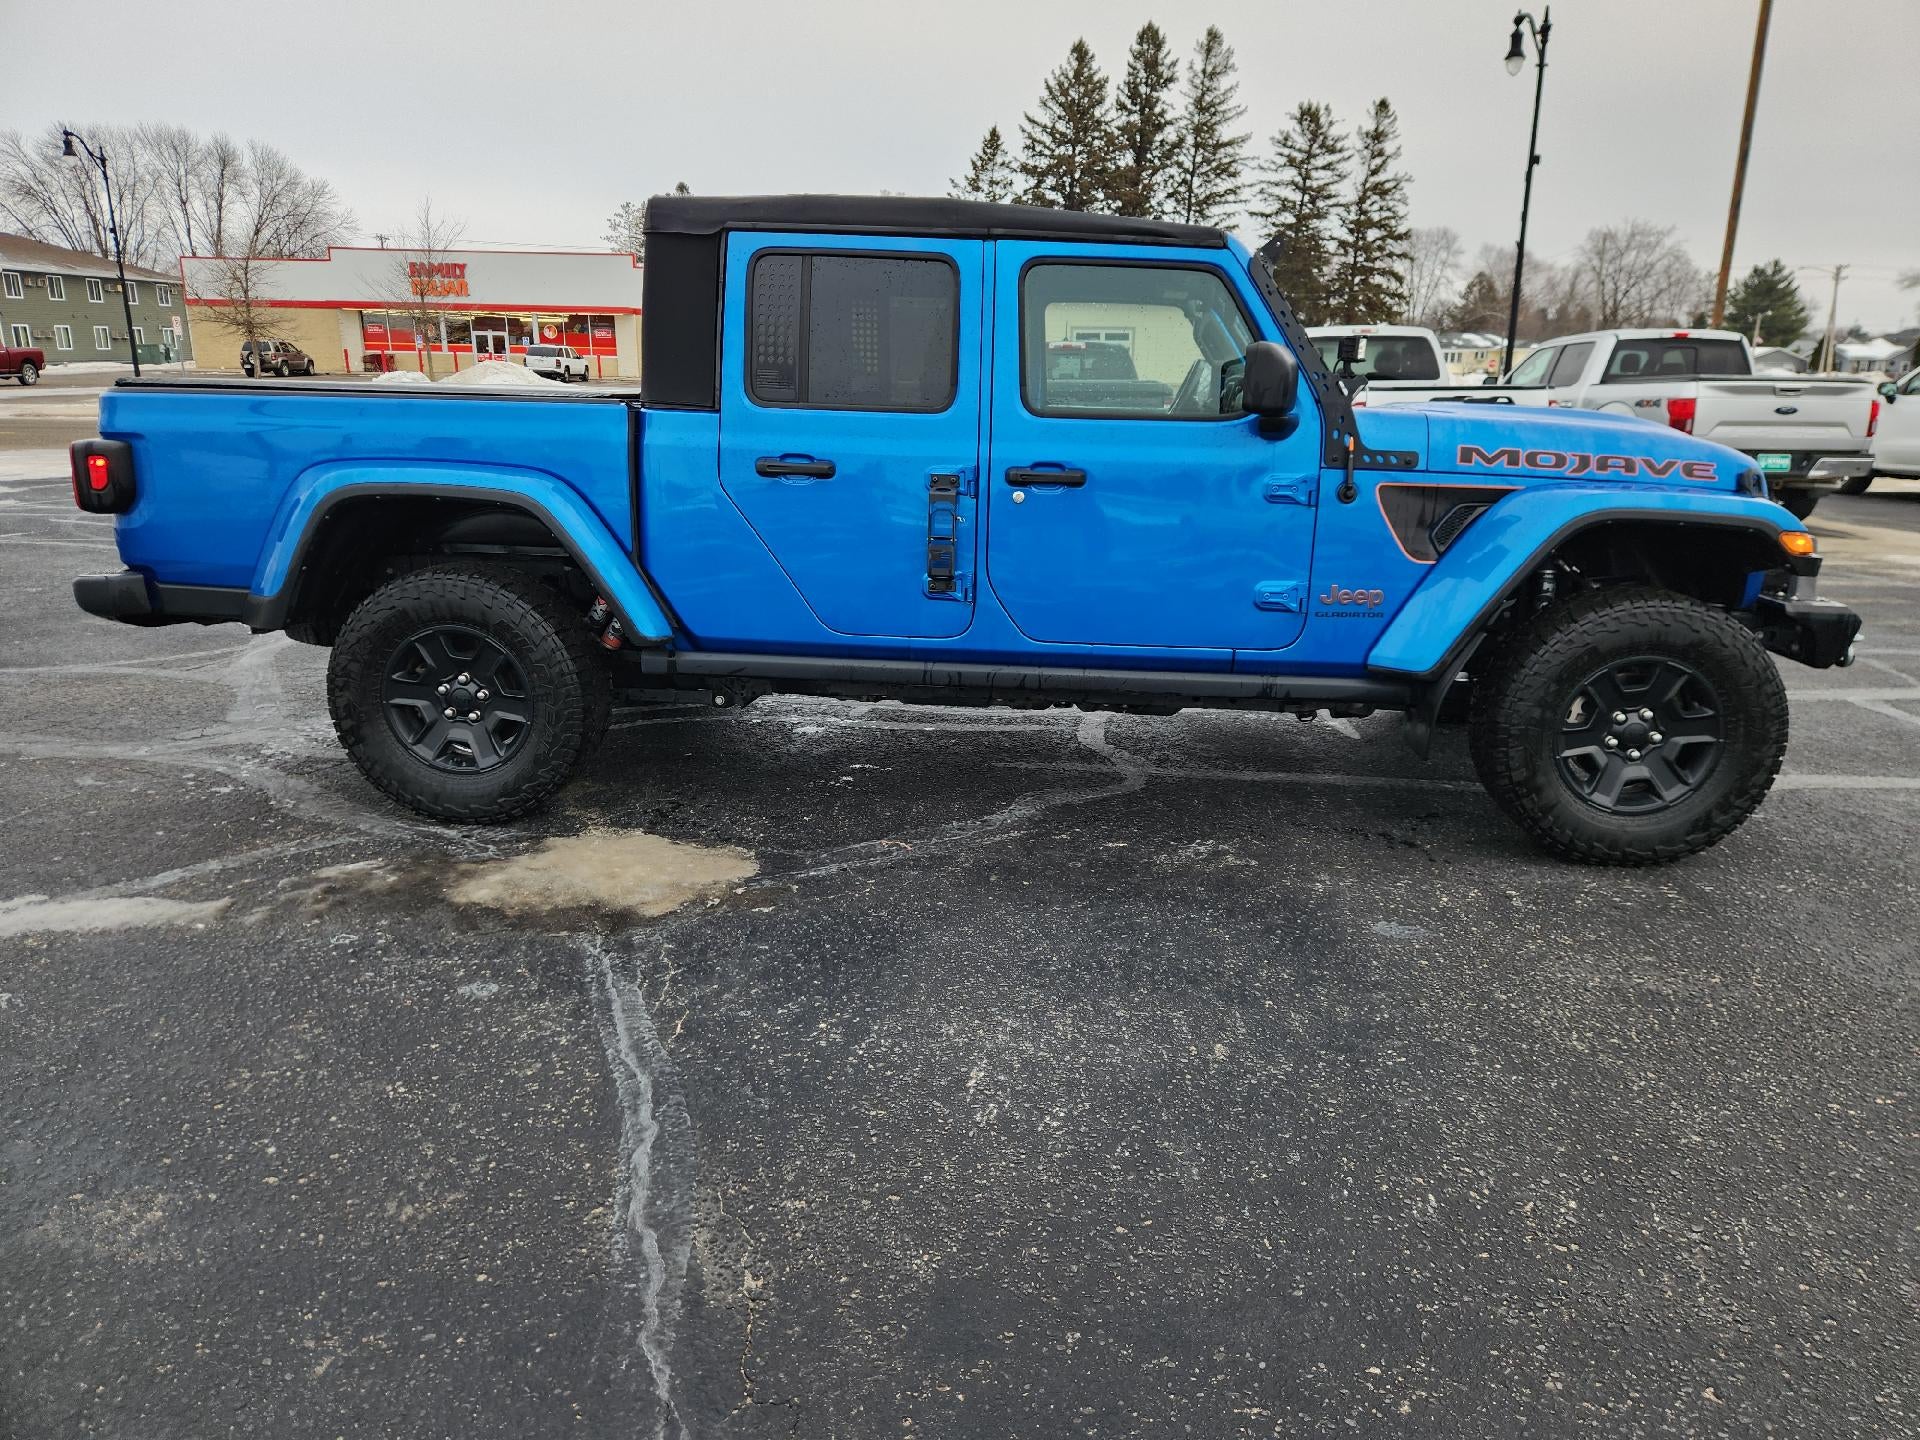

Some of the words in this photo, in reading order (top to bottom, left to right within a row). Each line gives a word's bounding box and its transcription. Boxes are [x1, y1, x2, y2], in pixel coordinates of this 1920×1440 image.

[408, 262, 467, 278] FAMILY
[1457, 445, 1718, 481] MOJAVE
[1320, 584, 1384, 609] Jeep
